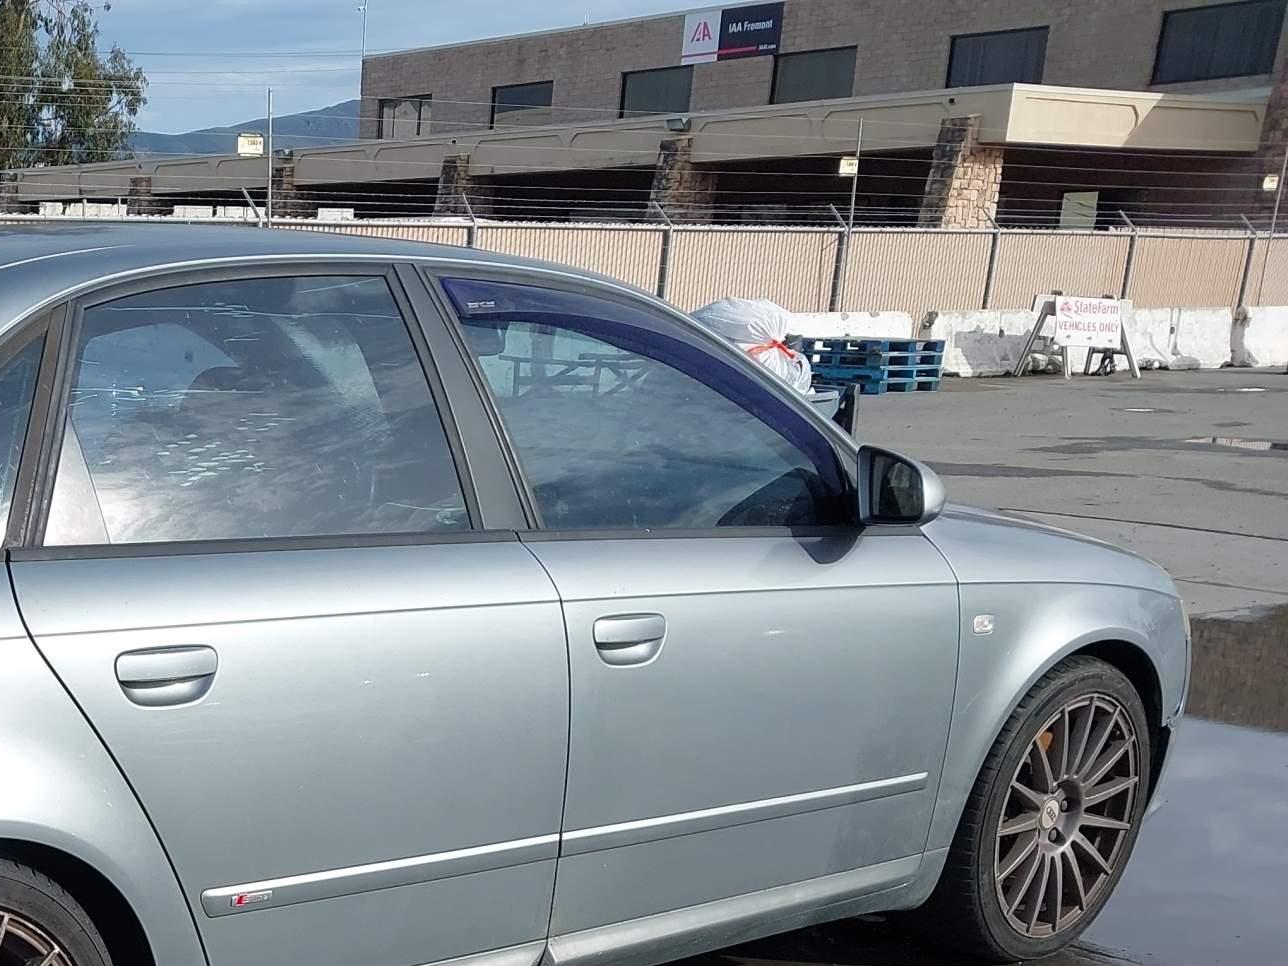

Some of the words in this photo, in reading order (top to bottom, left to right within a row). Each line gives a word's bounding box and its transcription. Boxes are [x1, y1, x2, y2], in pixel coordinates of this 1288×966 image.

[728, 22, 743, 34] IAA
[1058, 320, 1097, 333] VEHICLES
[1098, 321, 1120, 334] ONLY
